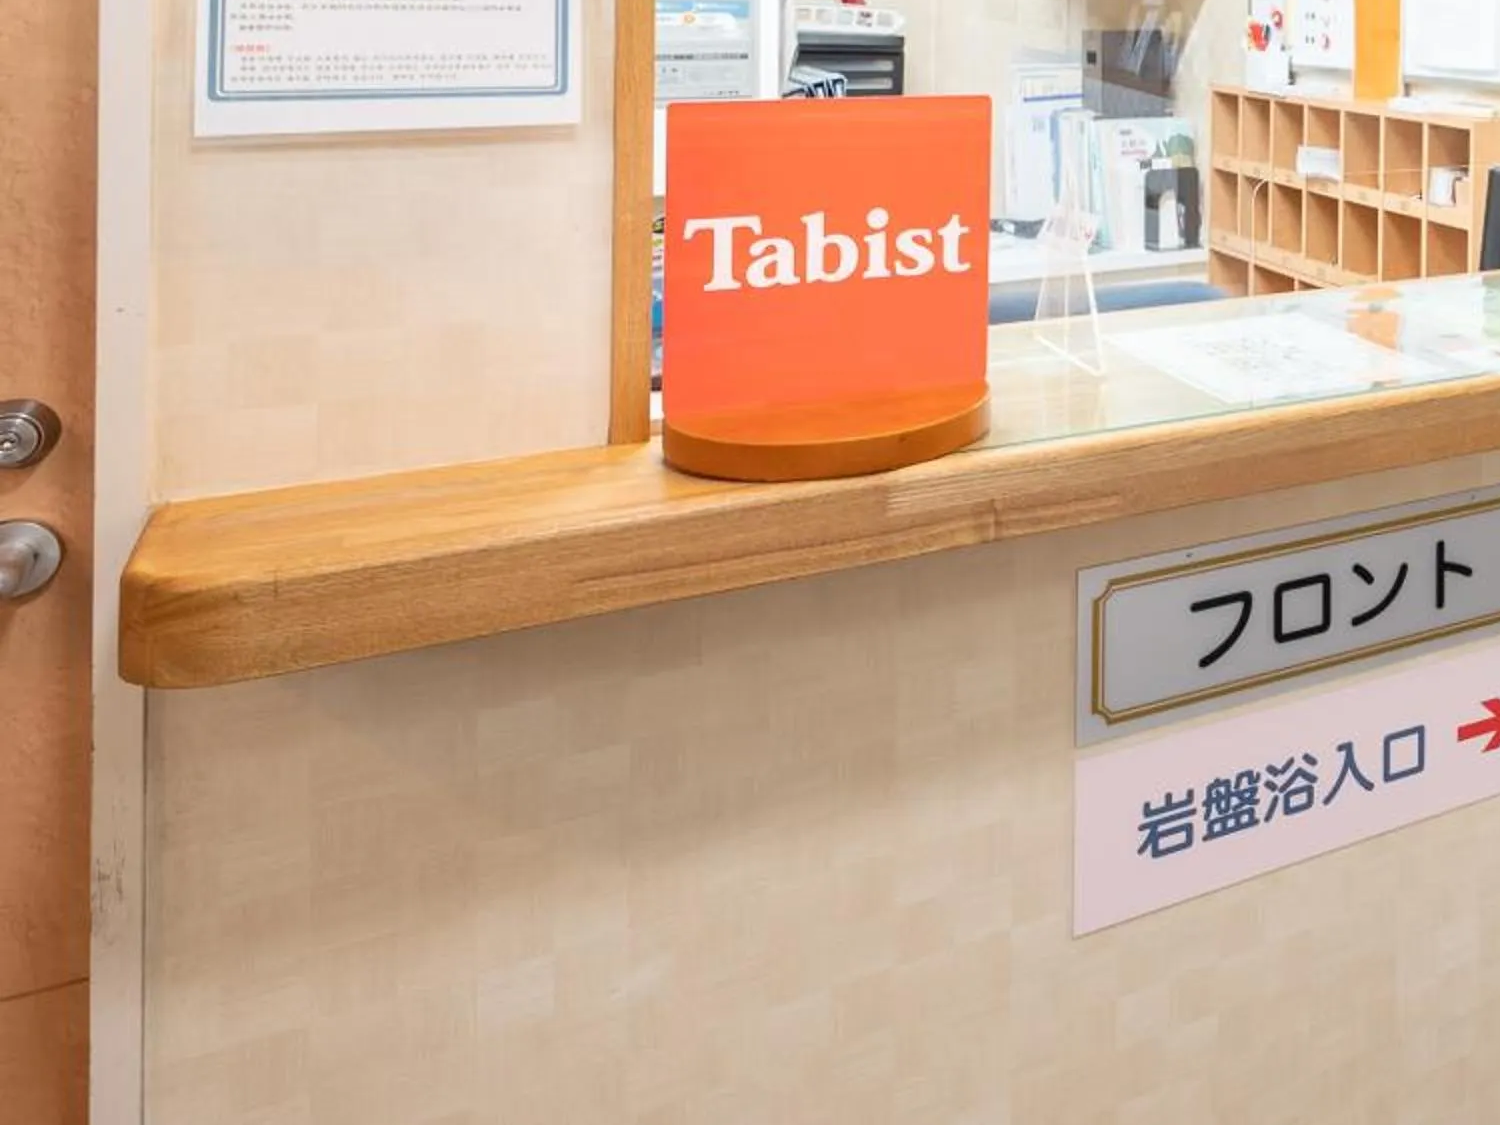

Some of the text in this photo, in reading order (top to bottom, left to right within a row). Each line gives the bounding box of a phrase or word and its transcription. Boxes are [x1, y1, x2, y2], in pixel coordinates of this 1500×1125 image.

[683, 207, 971, 292] Tabist
[1190, 540, 1473, 668] フロント
[1137, 725, 1426, 859] 岩盤浴入口
